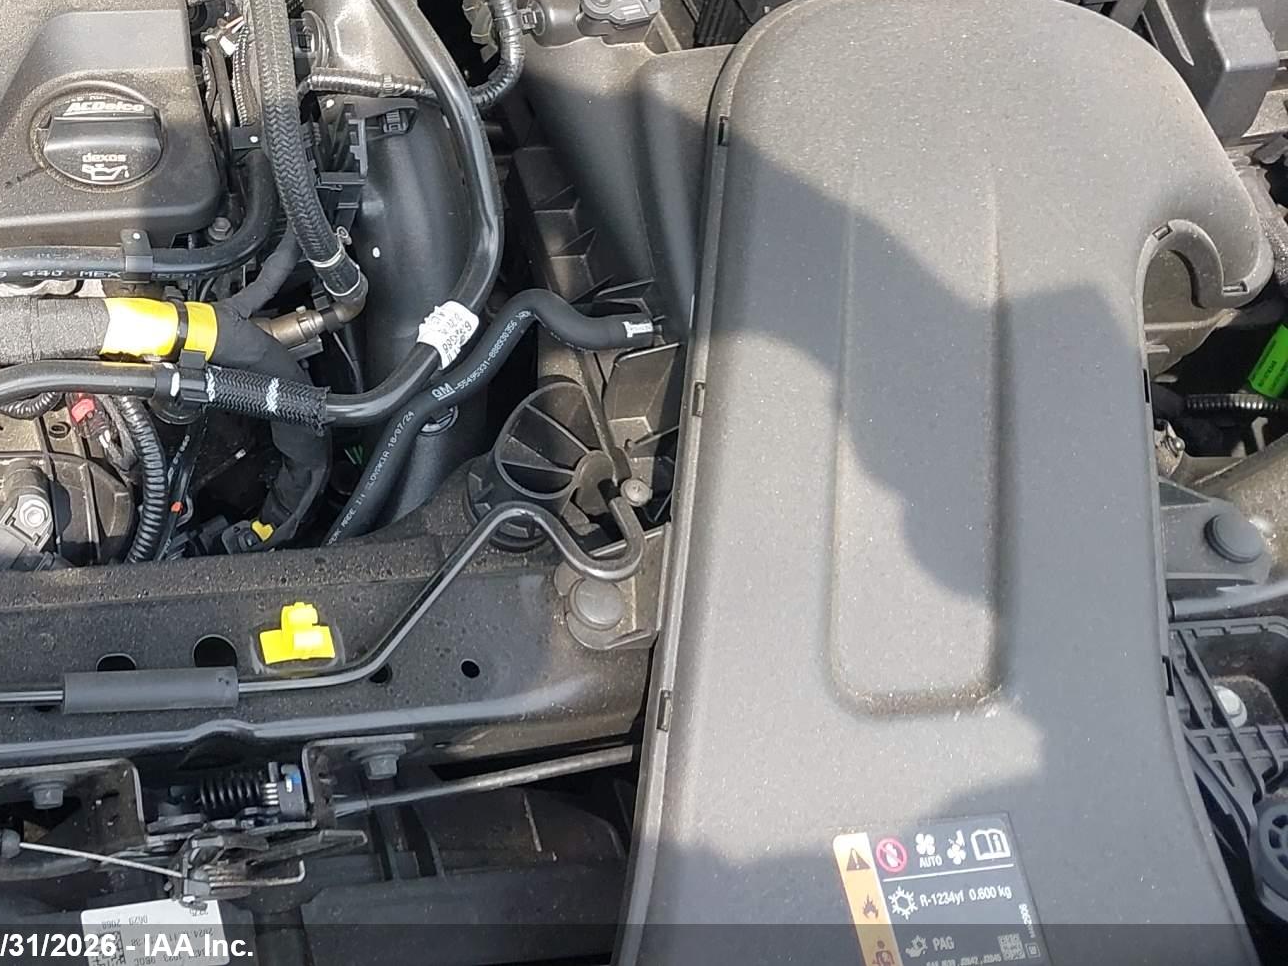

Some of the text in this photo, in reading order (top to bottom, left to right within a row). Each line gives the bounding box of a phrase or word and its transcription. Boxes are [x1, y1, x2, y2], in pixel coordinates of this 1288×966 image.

[63, 101, 144, 116] ACDelco
[82, 153, 127, 162] dexos
[79, 269, 121, 279] MEX
[432, 382, 456, 402] GM
[919, 855, 943, 869] AUTO
[919, 885, 1013, 908] R-1234yf 0.600 kg
[932, 935, 956, 951] PAG
